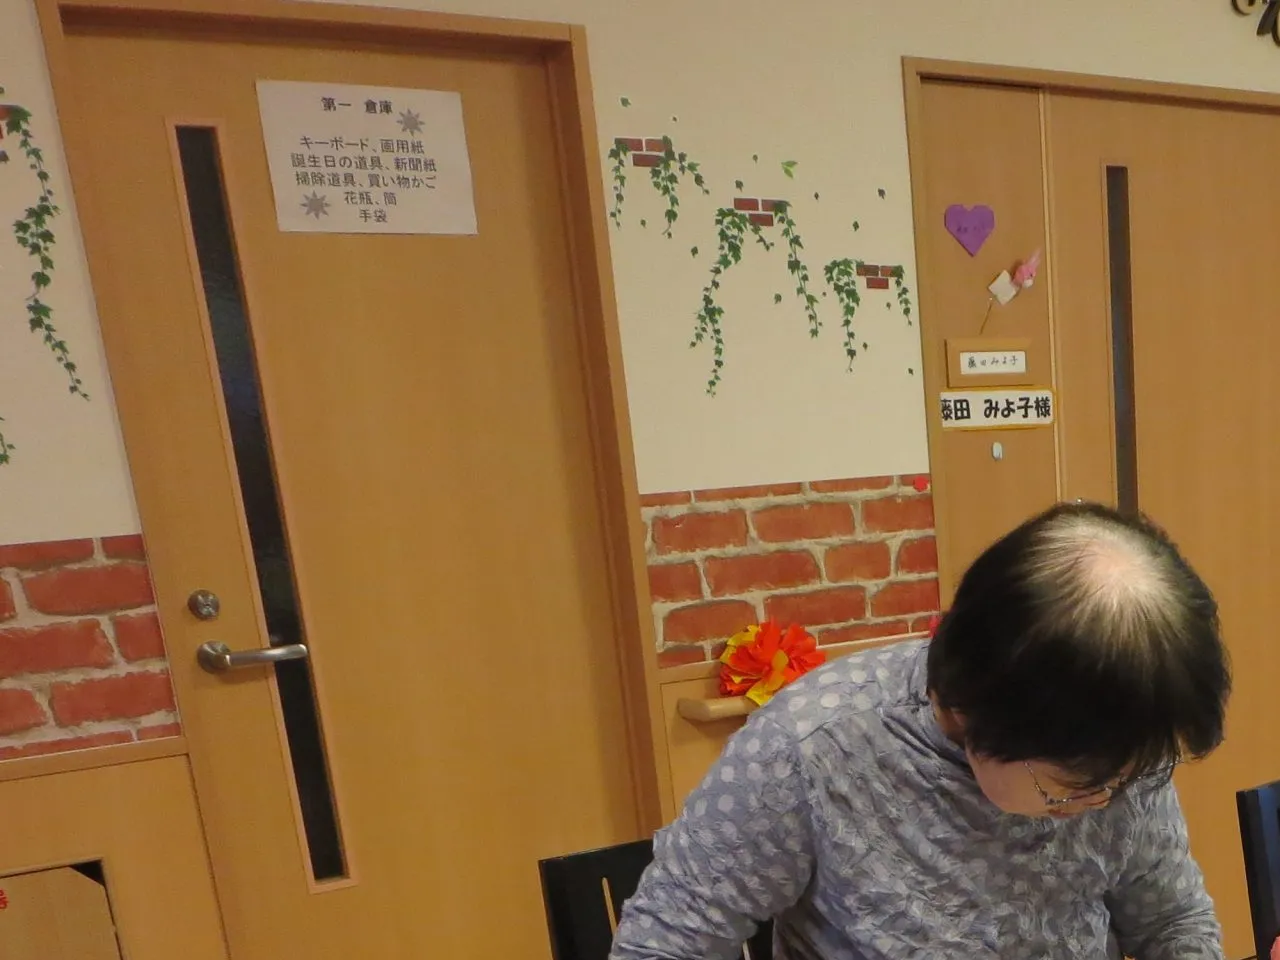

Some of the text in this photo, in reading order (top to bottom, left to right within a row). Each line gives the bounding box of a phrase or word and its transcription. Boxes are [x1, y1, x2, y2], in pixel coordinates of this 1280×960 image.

[321, 97, 393, 115] 第一 倉庫
[299, 135, 425, 154] キーボード、画用紙
[291, 153, 437, 172] 誕生日の道具、新聞紙
[296, 172, 437, 190] 掃除道具、買い物かご
[359, 209, 387, 223] 手袋
[983, 396, 1051, 419] みよ子様
